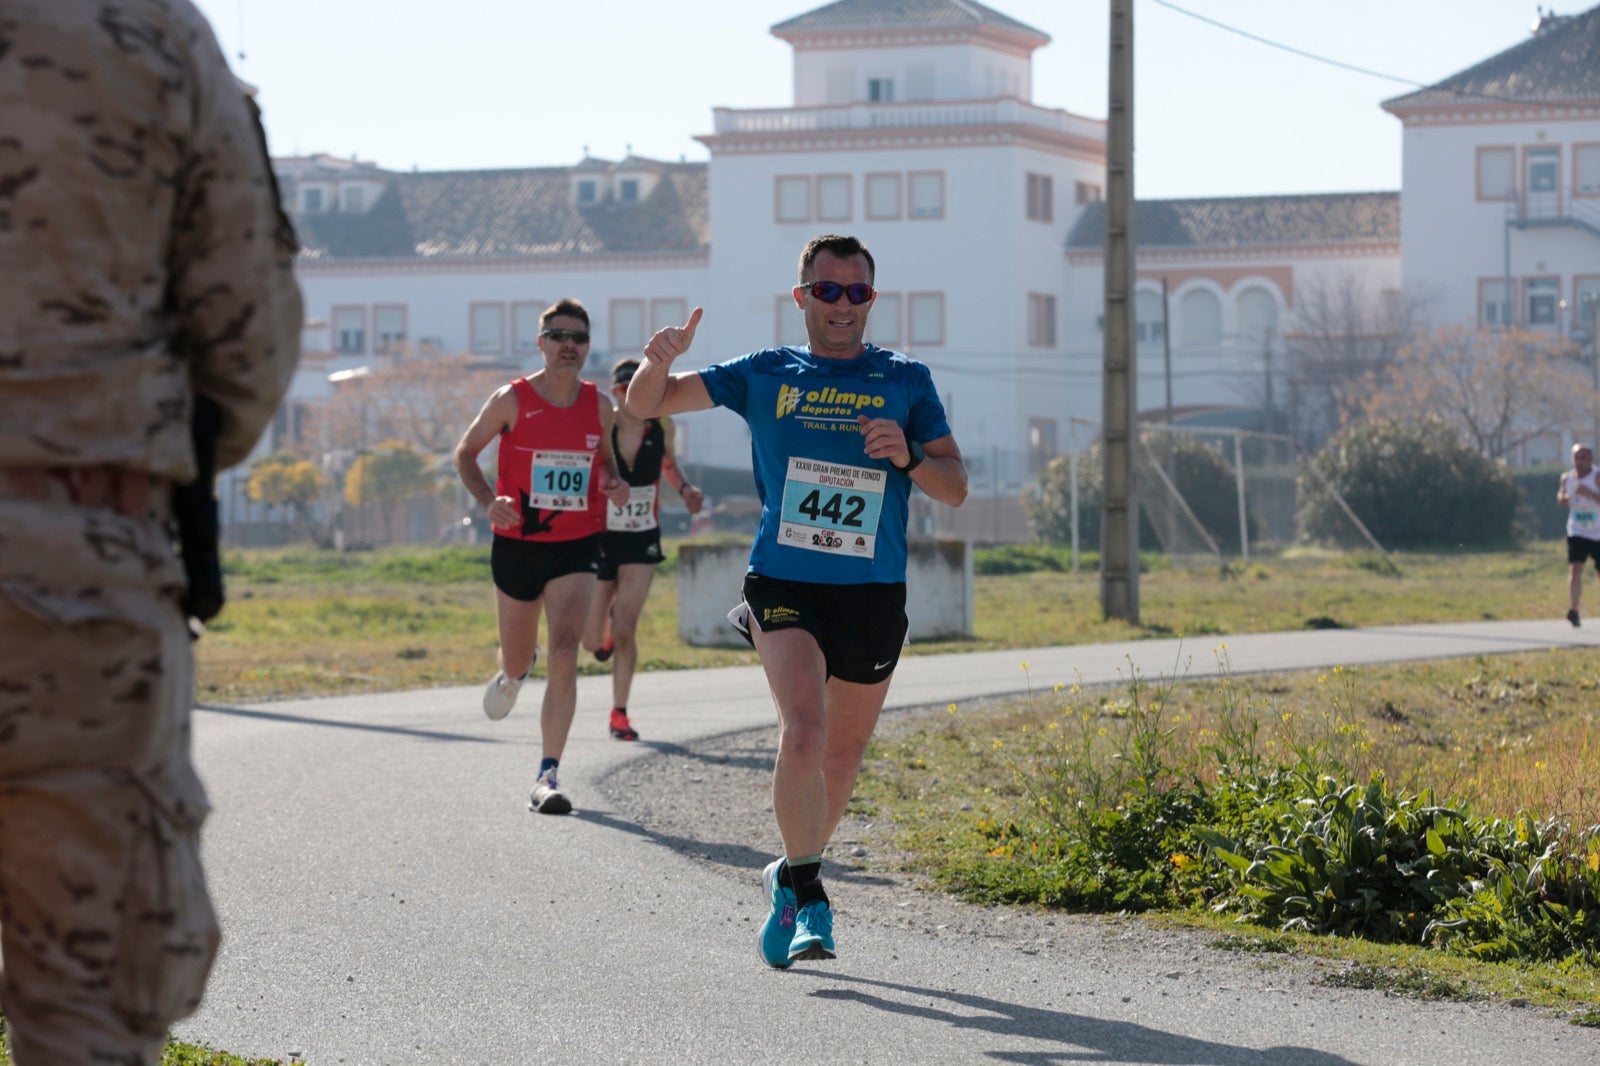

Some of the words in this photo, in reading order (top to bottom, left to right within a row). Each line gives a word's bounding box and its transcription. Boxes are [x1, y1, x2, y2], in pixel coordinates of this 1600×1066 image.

[806, 387, 885, 409] olimpo
[801, 404, 852, 415] deportes
[803, 421, 827, 430] TRAIL
[831, 423, 837, 431] &
[840, 424, 862, 432] RUN
[544, 470, 583, 492] 109
[812, 463, 829, 473] GRAN
[830, 466, 852, 477] PREMIO
[852, 469, 860, 479] DE
[861, 472, 881, 481] FONDO
[799, 489, 866, 527] 442
